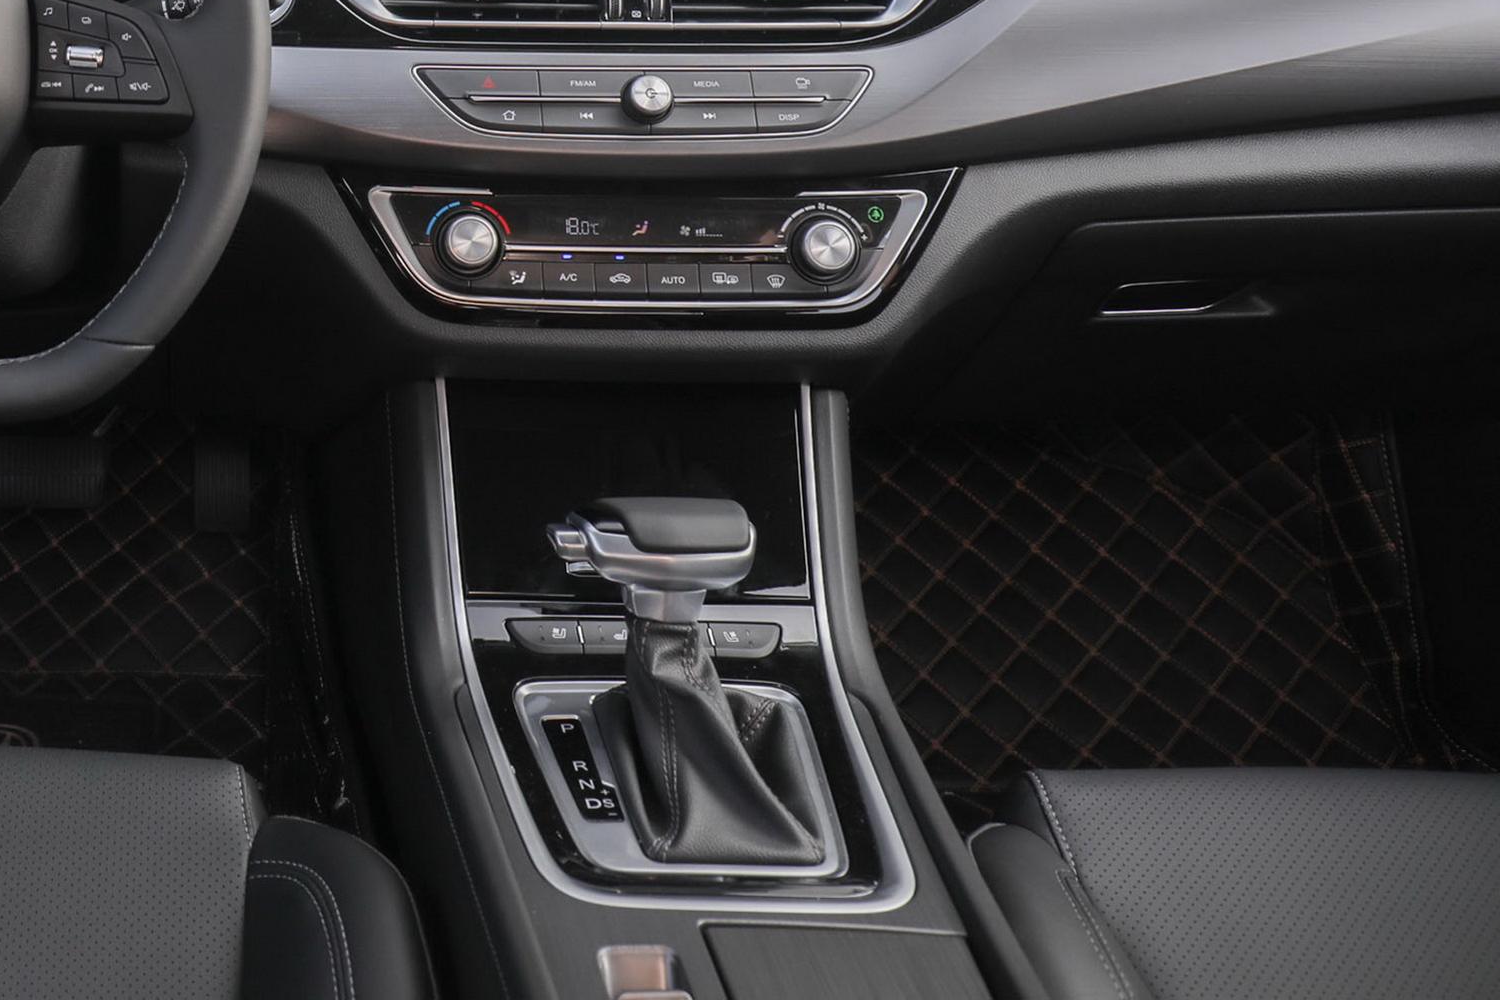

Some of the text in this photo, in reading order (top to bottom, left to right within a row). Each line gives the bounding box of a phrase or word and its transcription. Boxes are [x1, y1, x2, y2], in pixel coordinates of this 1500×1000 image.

[570, 79, 597, 88] FM/AM
[693, 80, 720, 88] MEDIA
[778, 113, 800, 122] DISP
[559, 273, 578, 282] A/C
[661, 275, 686, 285] AUTO
[560, 723, 575, 734] P
[572, 760, 589, 772] R
[578, 779, 596, 791] N
